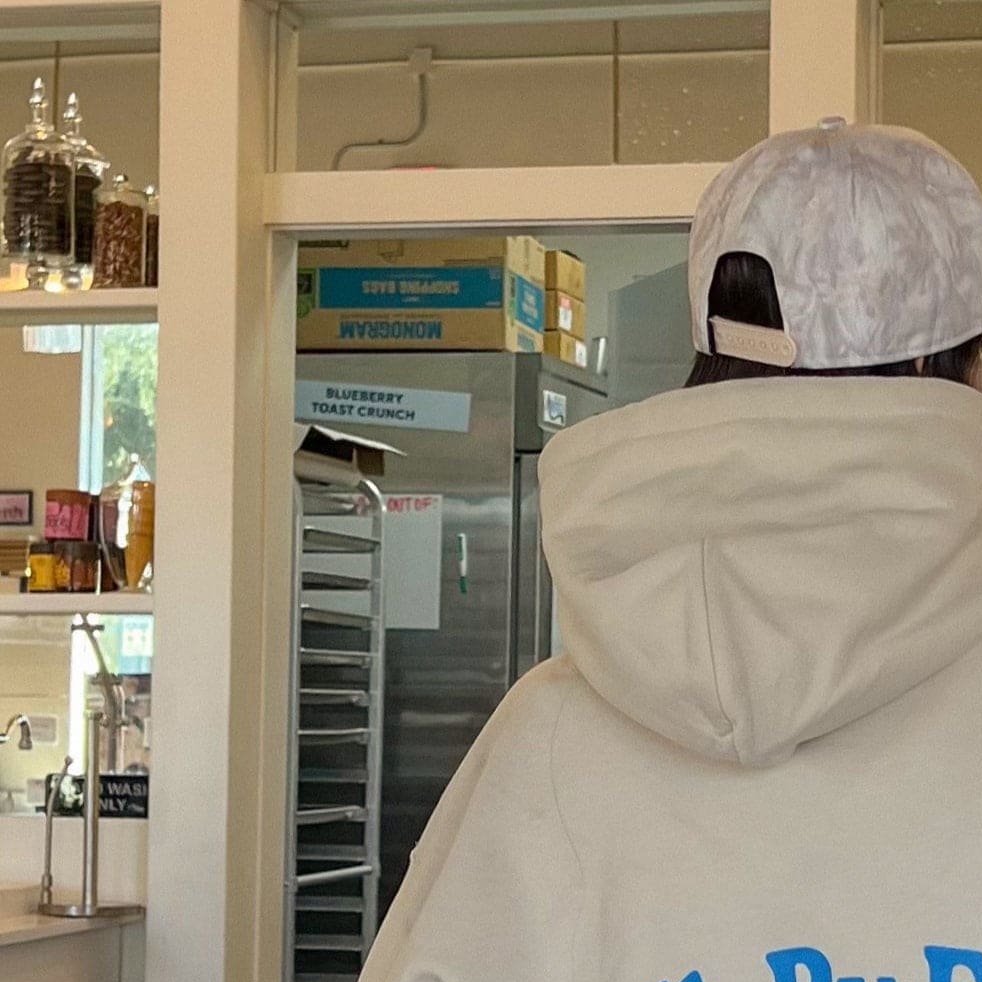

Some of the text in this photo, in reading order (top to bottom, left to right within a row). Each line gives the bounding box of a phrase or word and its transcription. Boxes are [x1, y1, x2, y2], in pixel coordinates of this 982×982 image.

[339, 321, 443, 340] MONOGRAM
[325, 387, 404, 404] BLUEBERRY
[311, 401, 416, 421] TOAST CRUNCH
[99, 798, 127, 811] NLY
